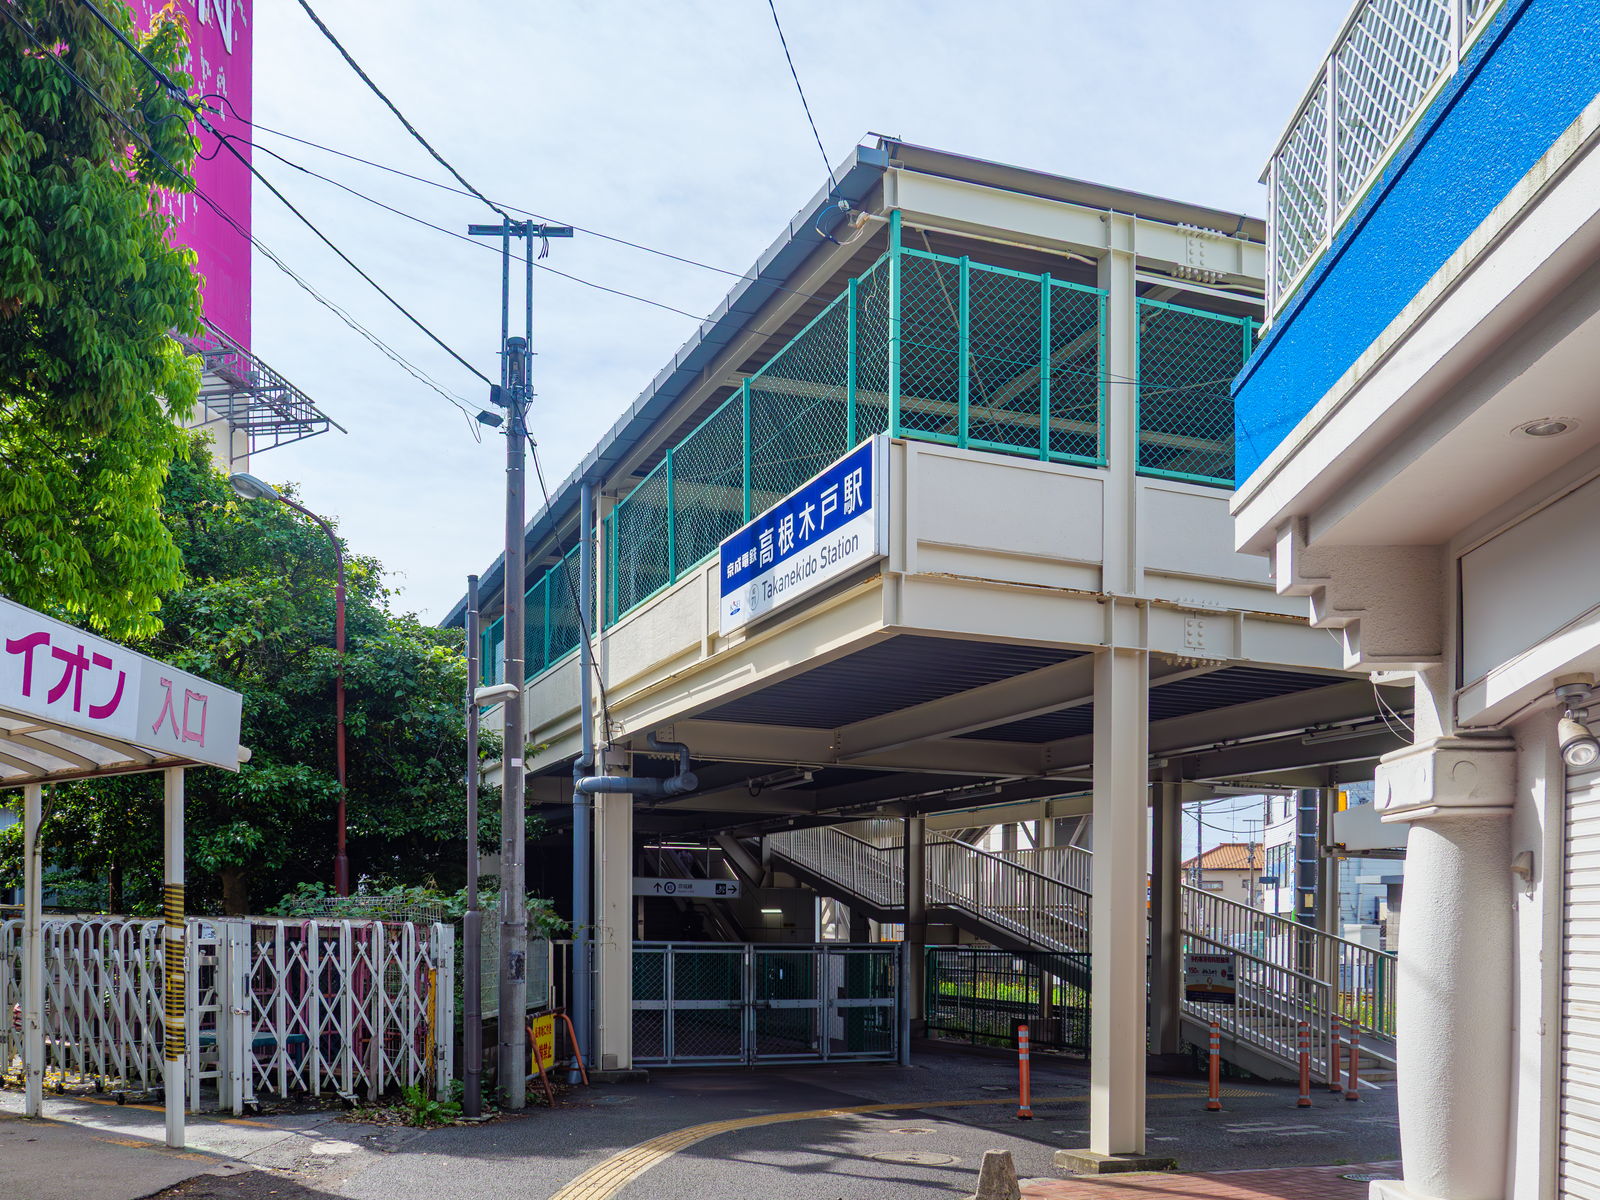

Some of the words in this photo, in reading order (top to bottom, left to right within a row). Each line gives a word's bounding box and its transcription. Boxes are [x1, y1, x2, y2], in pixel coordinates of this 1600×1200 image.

[726, 547, 757, 579] 京成電鉄
[758, 467, 863, 569] 高根木戸駅
[762, 557, 818, 601] Takanekido
[820, 534, 859, 569] Station
[5, 631, 126, 720] イオン
[152, 677, 209, 748] 入口
